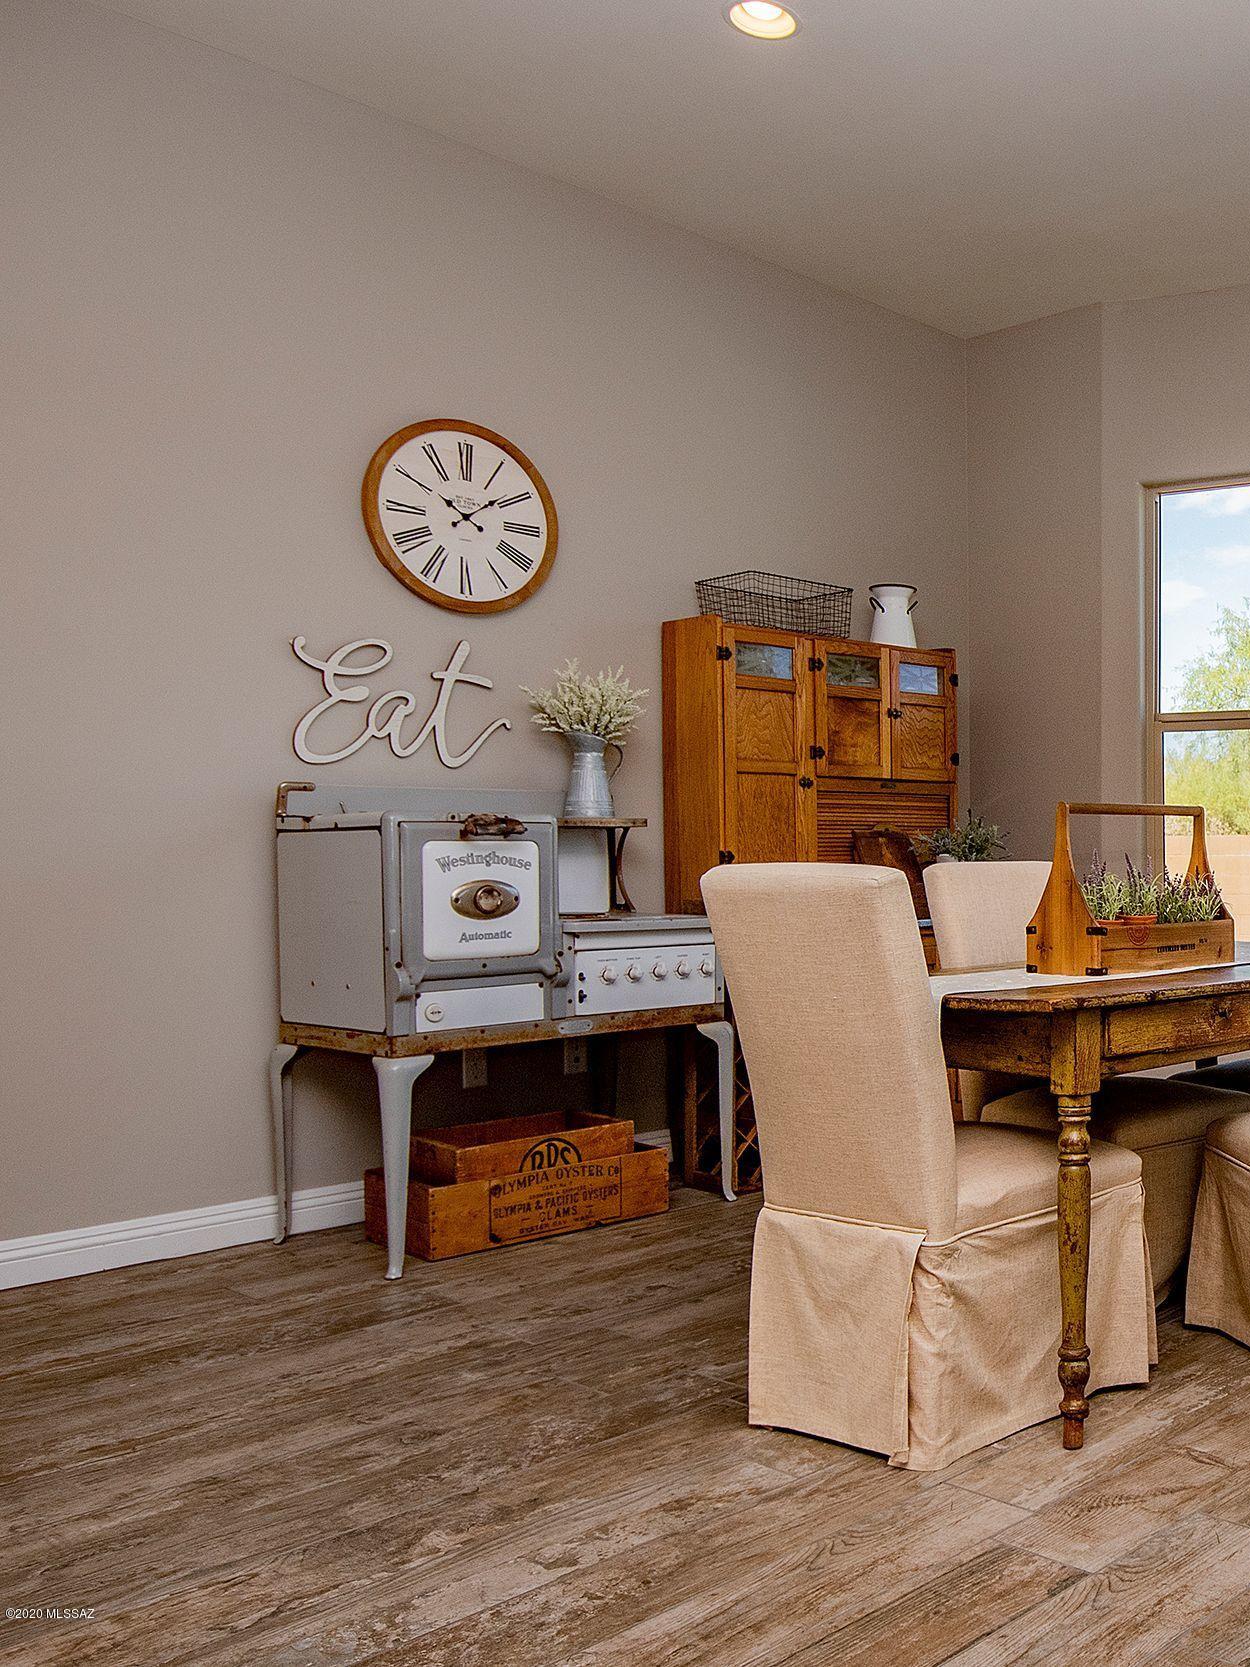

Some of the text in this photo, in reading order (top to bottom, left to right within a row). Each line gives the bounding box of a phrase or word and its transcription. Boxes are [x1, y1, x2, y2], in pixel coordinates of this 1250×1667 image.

[292, 636, 512, 768] Eat
[435, 851, 532, 873] Westinghouse
[459, 930, 512, 943] Automatic
[556, 1165, 603, 1180] OYSTER
[535, 1199, 543, 1211] &
[546, 1192, 579, 1209] PACIFIC
[582, 1184, 619, 1201] OYSTERS
[539, 1206, 578, 1223] CLAMS
